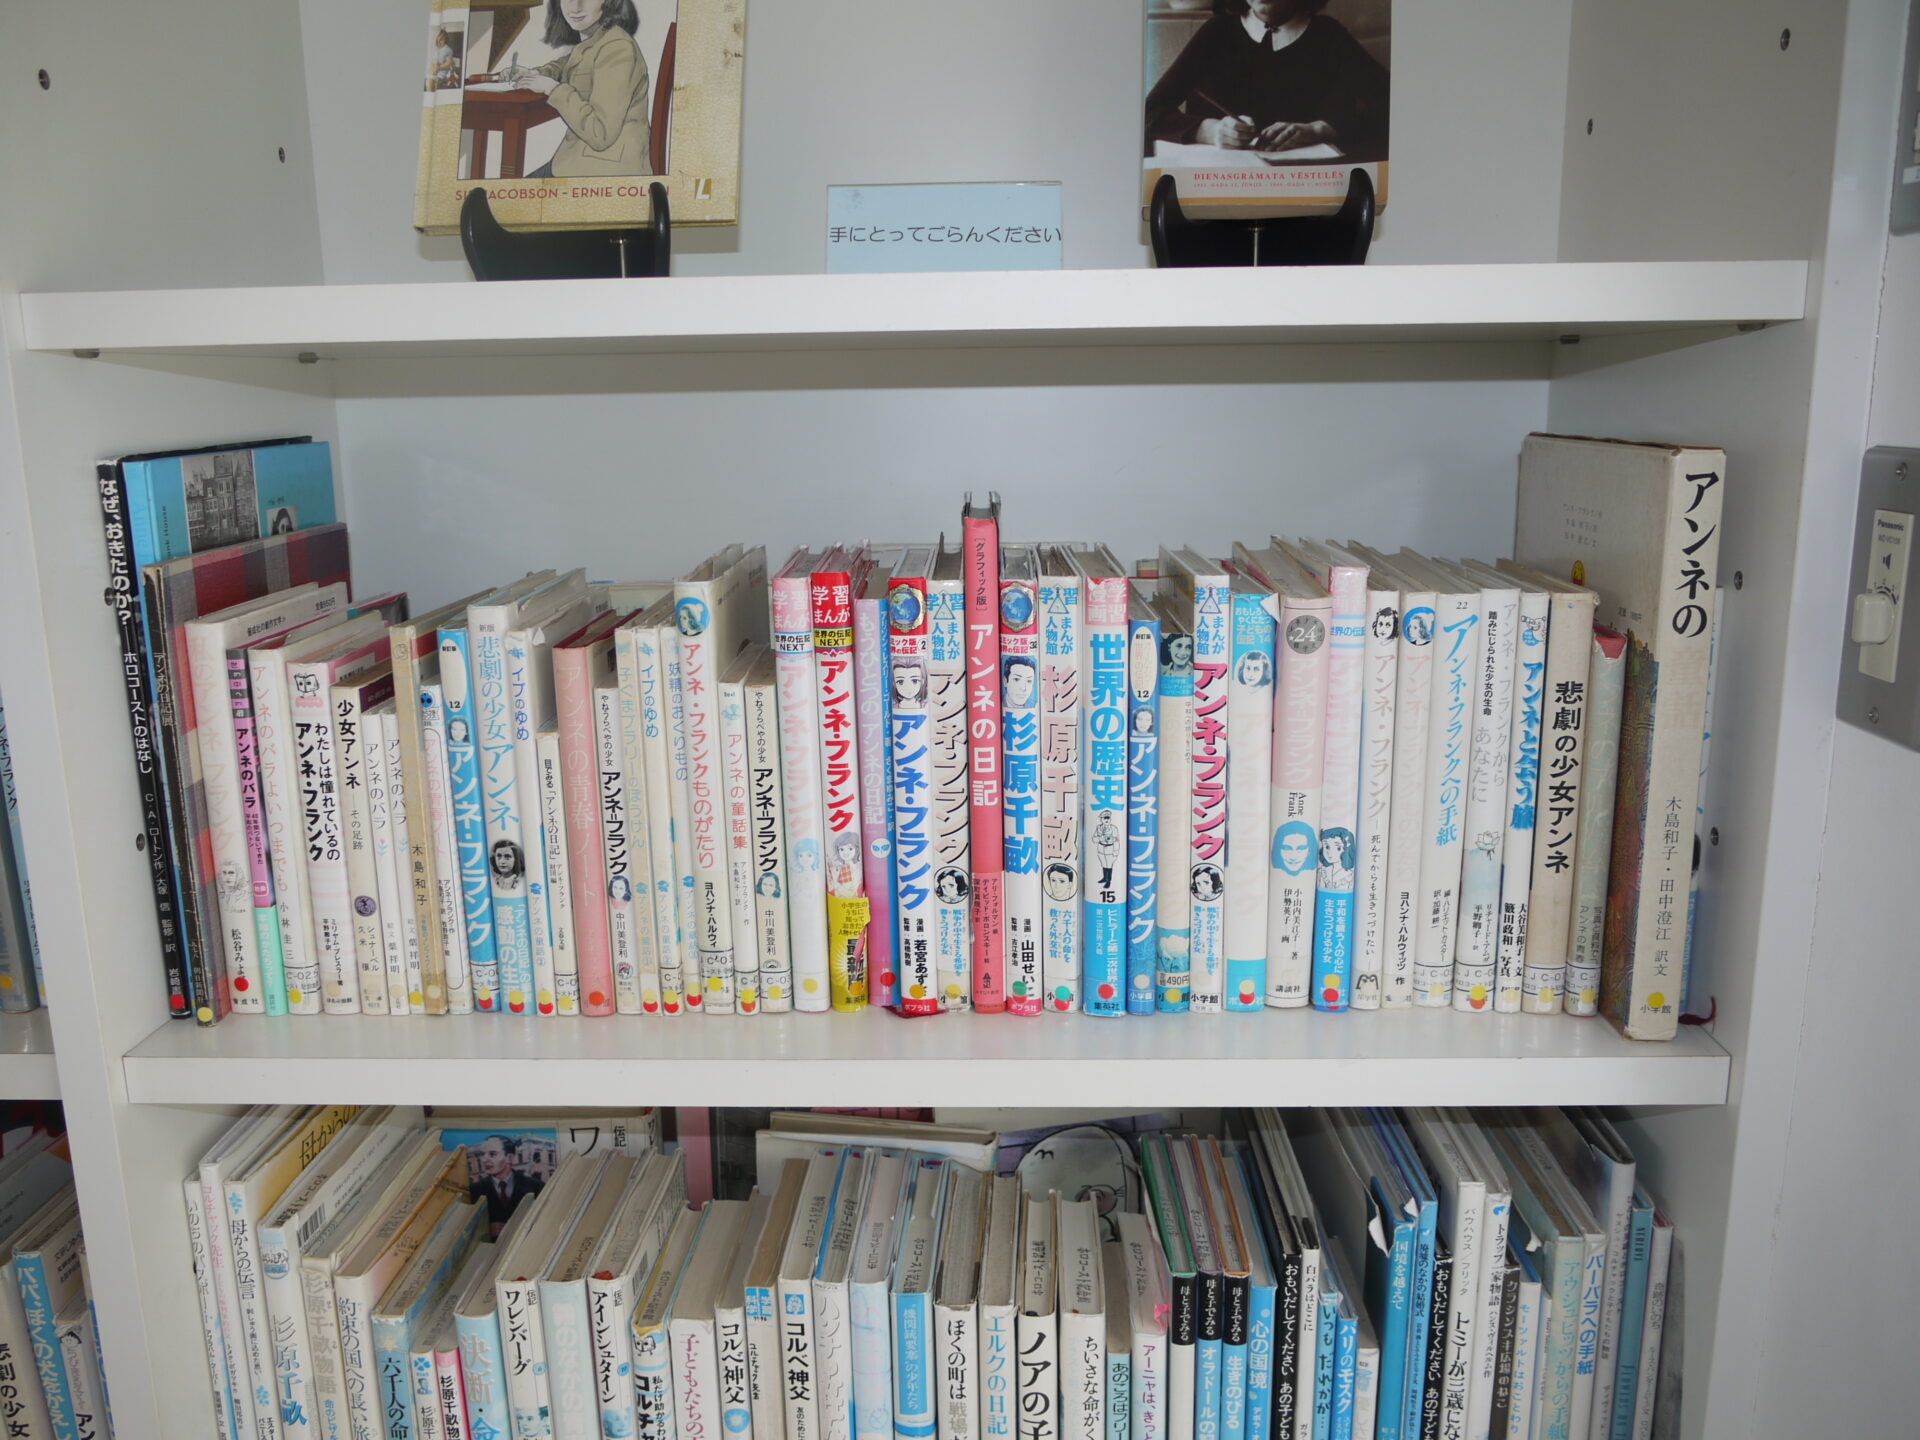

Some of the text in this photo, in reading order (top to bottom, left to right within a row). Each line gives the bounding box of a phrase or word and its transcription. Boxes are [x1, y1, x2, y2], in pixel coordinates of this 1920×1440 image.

[484, 188, 558, 200] ACOBSON
[572, 186, 612, 198] ERNIE
[617, 186, 669, 197] COL
[1193, 170, 1345, 181] DIENASGRĀMATA VĒSTULĒS
[829, 225, 1061, 246] 手にとってごらんください
[775, 634, 811, 643] 世界の伝記
[813, 585, 851, 624] 学習 まんが
[814, 630, 852, 639] 世界の伝記
[819, 638, 846, 646] NEXT
[921, 640, 927, 650] 2
[932, 621, 945, 661] 人物館
[947, 623, 960, 660] まんが
[1046, 616, 1058, 656] 人物館
[1060, 616, 1073, 655] まんが
[1196, 616, 1209, 655] 人物館
[1212, 616, 1225, 655] まんが
[1293, 626, 1317, 642] 24
[511, 668, 529, 741] イブのゆめ
[641, 665, 659, 739] イブのゆめ
[1137, 690, 1149, 698] 12
[1483, 610, 1498, 716] 踏みにじられた少女の生命
[337, 700, 361, 789] 少女アンネ
[477, 636, 520, 832] 悲劇の少女アンネ
[668, 661, 688, 782] 妖精のおくりもの
[682, 643, 715, 869] アンネ・フランクものがたり
[820, 660, 855, 833] アンネ・フランク
[859, 610, 885, 826] もうひとつのアンネの日記
[969, 623, 999, 807] アンネの日記
[1435, 614, 1480, 847] アンネ・フランクへの手紙
[236, 728, 257, 808] アンネのバラ
[296, 722, 341, 862] わたしは憧れているの アンネ・フランク
[366, 743, 387, 830] アンネのバラ
[387, 739, 407, 826] アンネのバラ
[727, 733, 747, 849] アンネの童話集
[1003, 712, 1039, 874] 杉原千畝
[1089, 633, 1126, 903] 世界の歴史 15
[1191, 663, 1228, 861] アンネ・フランク
[1287, 791, 1297, 817] Frank
[1298, 791, 1307, 816] Anne
[1545, 680, 1585, 874] 悲劇の少女アンネ
[447, 701, 491, 948] 12 アンネ・フランク
[600, 695, 614, 767] やねうらべやの少女
[615, 912, 628, 959] 中川美登利
[754, 692, 767, 764] やねうらべやの少女
[765, 909, 776, 956] 中川美登利
[892, 712, 932, 911] アンネ・フランク
[1128, 736, 1158, 944] アンネ・フランク
[412, 844, 428, 906] 木島和子
[1656, 796, 1682, 941] 木島和子・田中澄江
[1191, 995, 1219, 1004] 小学館
[1275, 985, 1300, 993] 講談社
[231, 1219, 256, 1300] 母からの伝言
[1303, 1265, 1317, 1332] 白バラはどこに
[504, 1290, 532, 1376] ワレンバーグ
[592, 1290, 616, 1404] アインシュタイン
[1179, 1285, 1191, 1341] 母と子でみる
[1205, 1279, 1217, 1336] 母と子でみる
[1281, 1264, 1298, 1376] おもいだしてください
[1427, 1268, 1451, 1381] おもいだしてください
[1576, 1255, 1603, 1375] バーバラへの手紙
[273, 1314, 307, 1426] 杉原千畝
[721, 1323, 745, 1404] コルベ神父
[786, 1322, 811, 1401] コルベ神父
[987, 1316, 1008, 1435] エルクの日記
[1019, 1332, 1053, 1440] ノアの子
[1226, 1286, 1243, 1430] 母と子でみる 生きのびる
[1249, 1319, 1270, 1390] 心の国境
[382, 1356, 409, 1440] 六千人の命
[440, 1376, 461, 1440] 杉原千畝物
